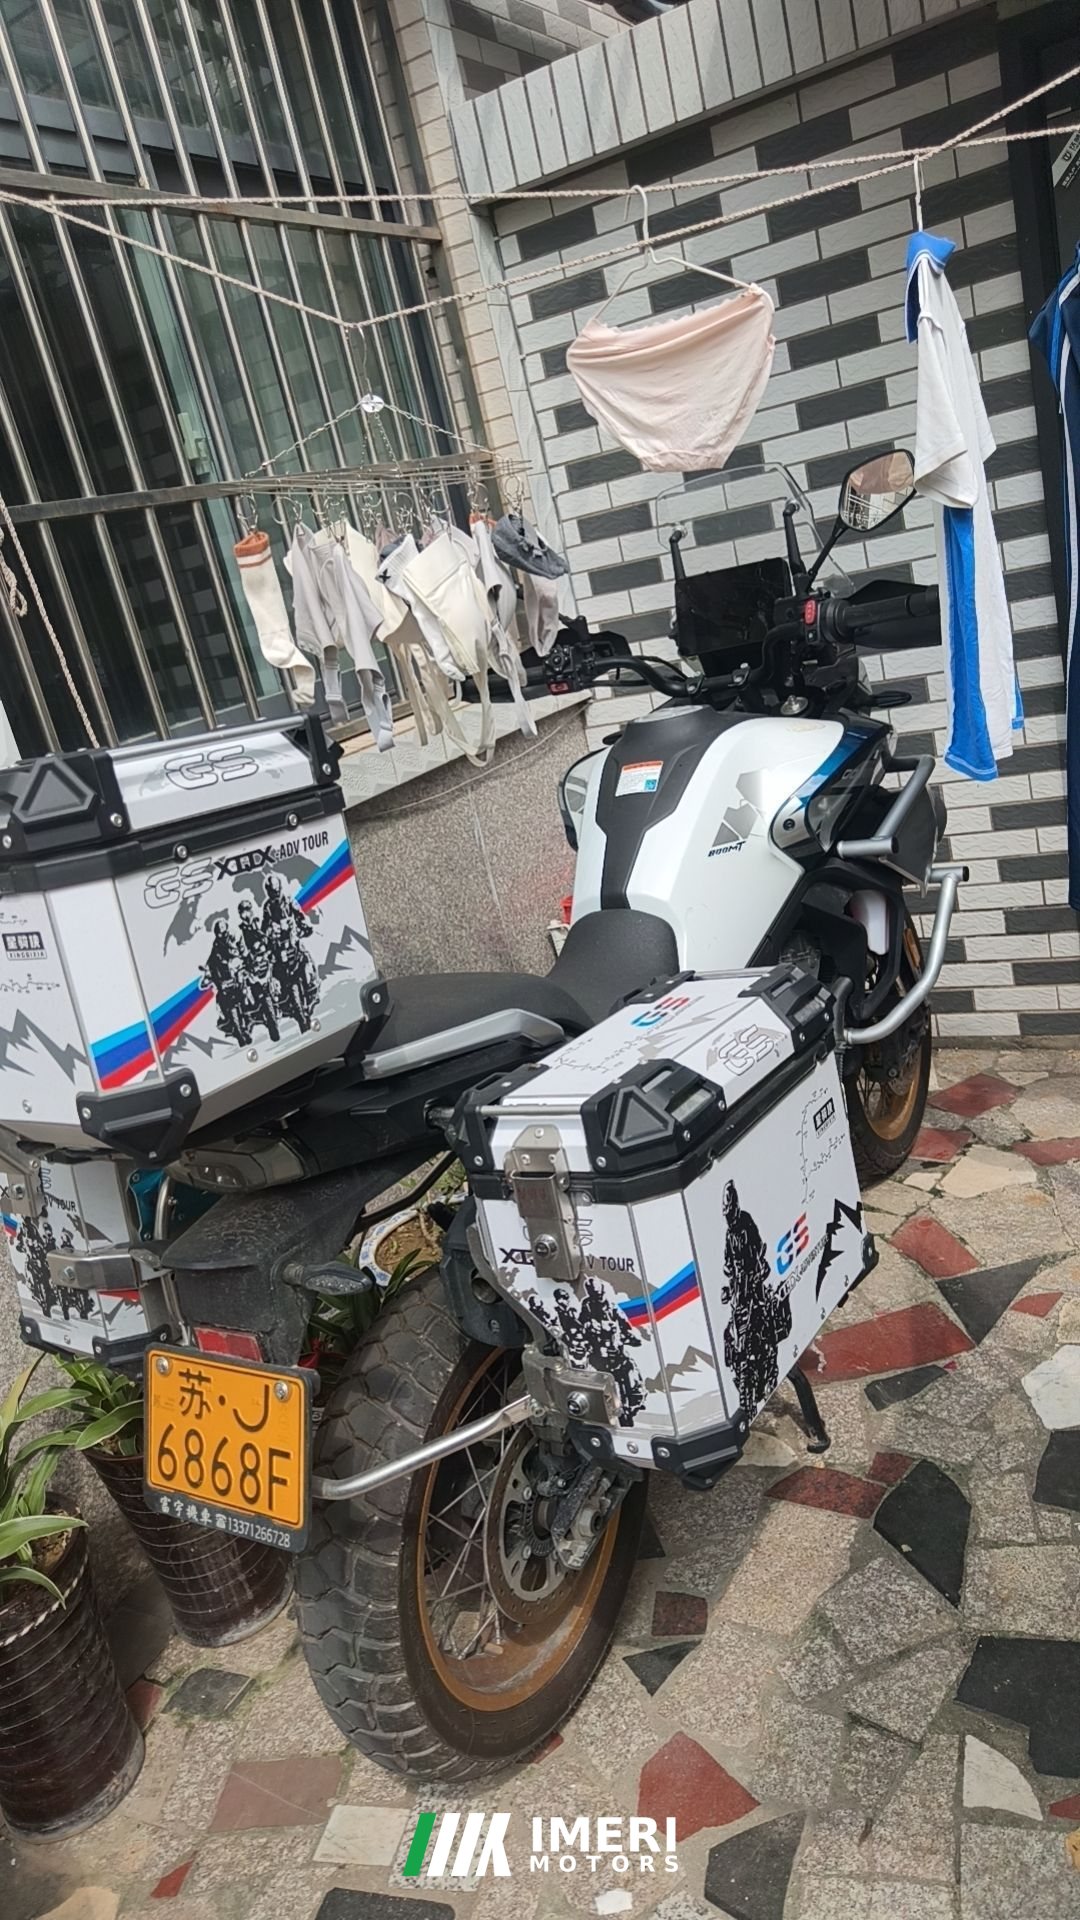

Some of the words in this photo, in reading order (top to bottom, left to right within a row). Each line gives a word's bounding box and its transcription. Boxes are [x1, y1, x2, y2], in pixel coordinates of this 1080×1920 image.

[301, 831, 329, 852] TOUR
[707, 840, 747, 857] 800MT
[600, 1256, 635, 1272] TOUR
[157, 1423, 291, 1512] 6868F
[228, 1517, 291, 1548] 13371266728
